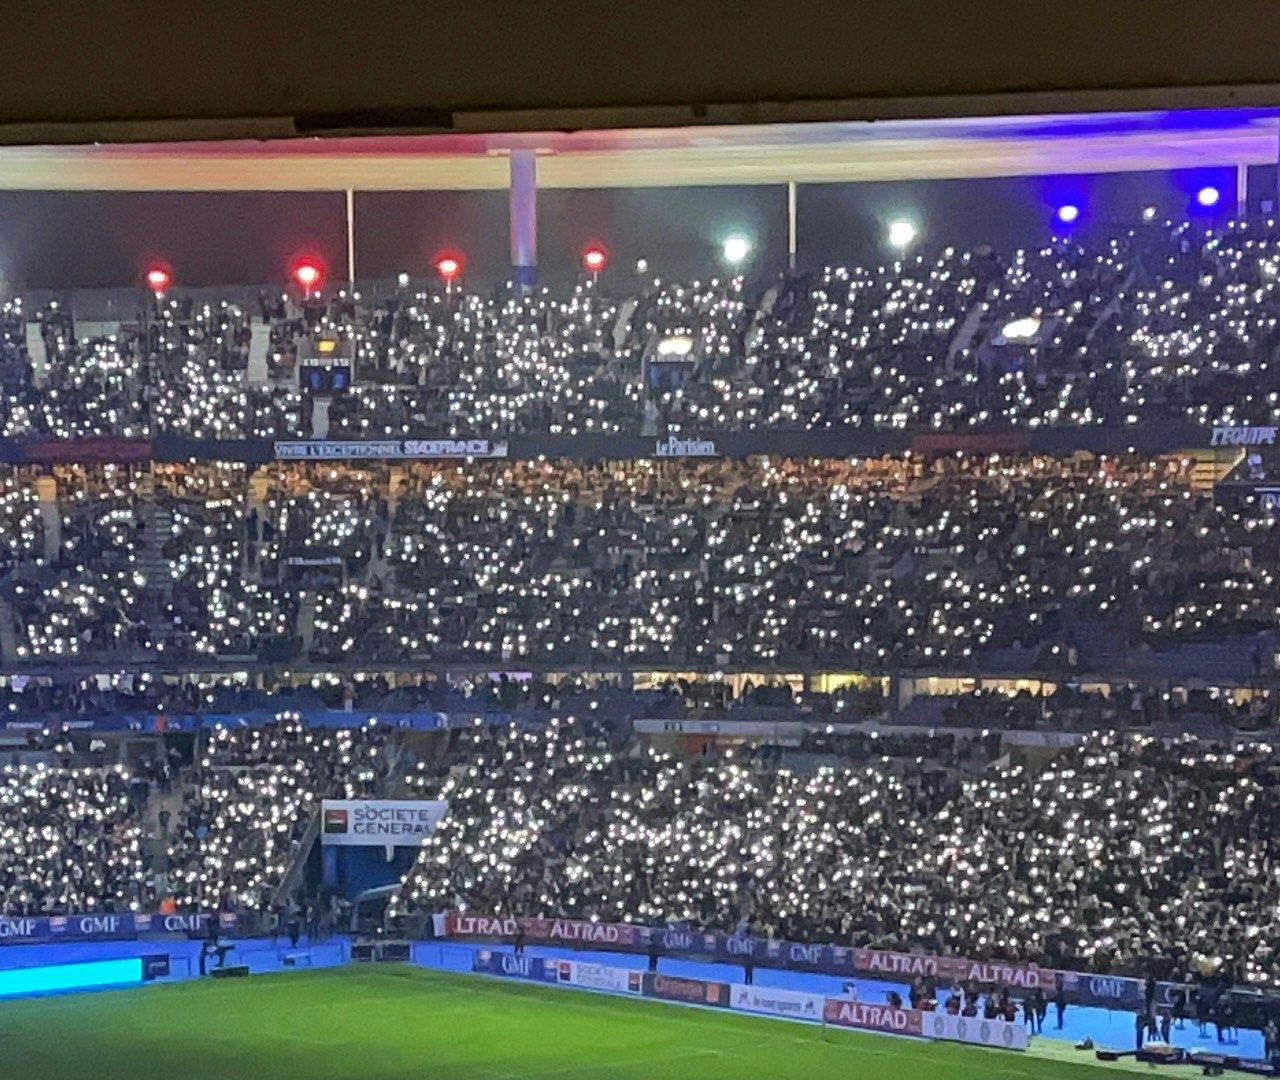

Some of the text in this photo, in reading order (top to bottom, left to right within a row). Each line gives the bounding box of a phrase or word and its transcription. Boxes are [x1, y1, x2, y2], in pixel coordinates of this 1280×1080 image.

[353, 807, 430, 821] SOCIETE
[353, 821, 431, 835] GENERAL
[80, 913, 120, 934] GMF
[550, 921, 620, 943] ALTRAD
[502, 954, 533, 975] GMF
[870, 952, 938, 977] ALTRAD
[969, 963, 1040, 988] ALTRAD
[838, 1003, 908, 1028] ALTRAD
